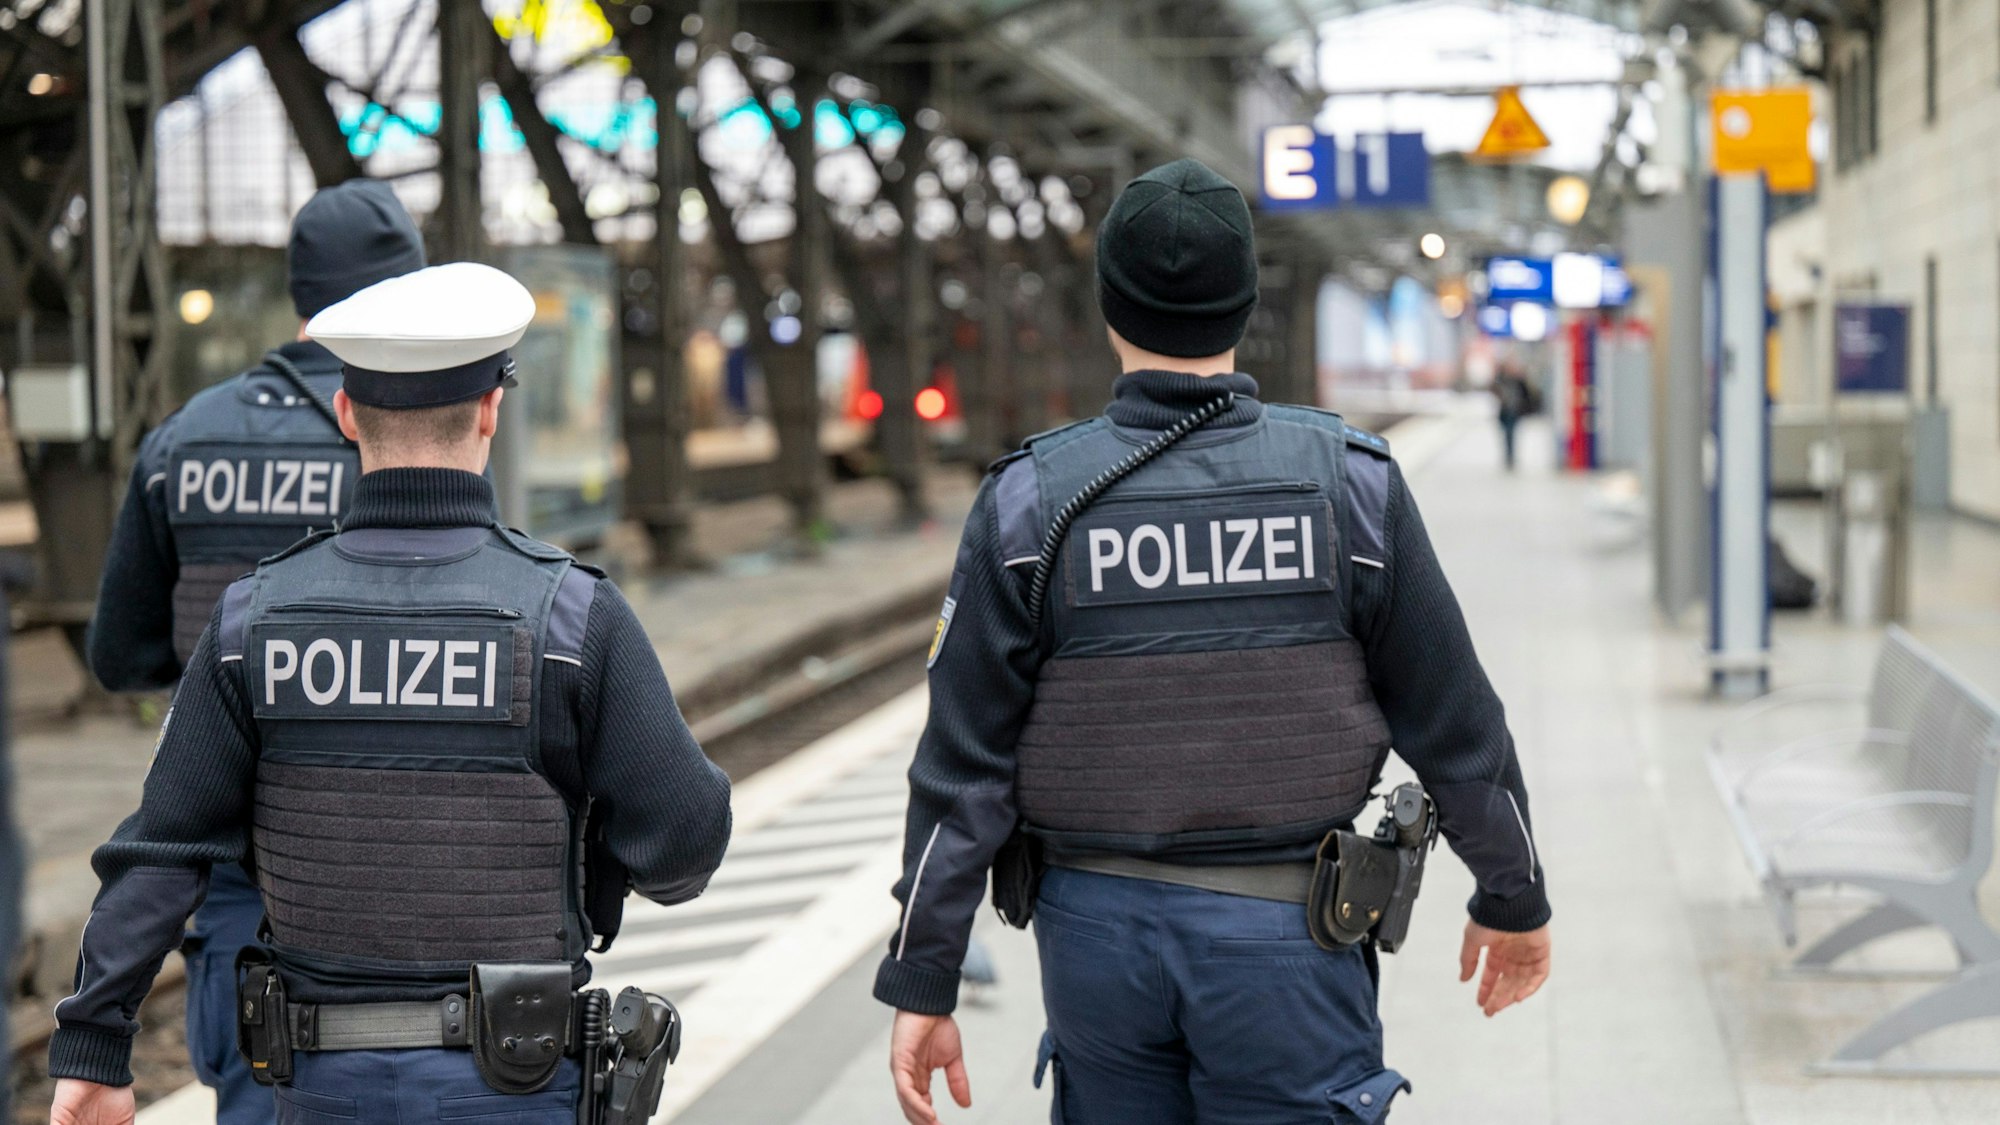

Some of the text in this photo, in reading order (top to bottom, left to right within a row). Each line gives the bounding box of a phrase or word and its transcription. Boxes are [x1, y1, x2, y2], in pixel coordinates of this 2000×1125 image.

[1264, 124, 1317, 200] E
[178, 459, 344, 516] POLIZEI
[1088, 515, 1315, 593] POLIZEI
[264, 637, 497, 707] POLIZEI
